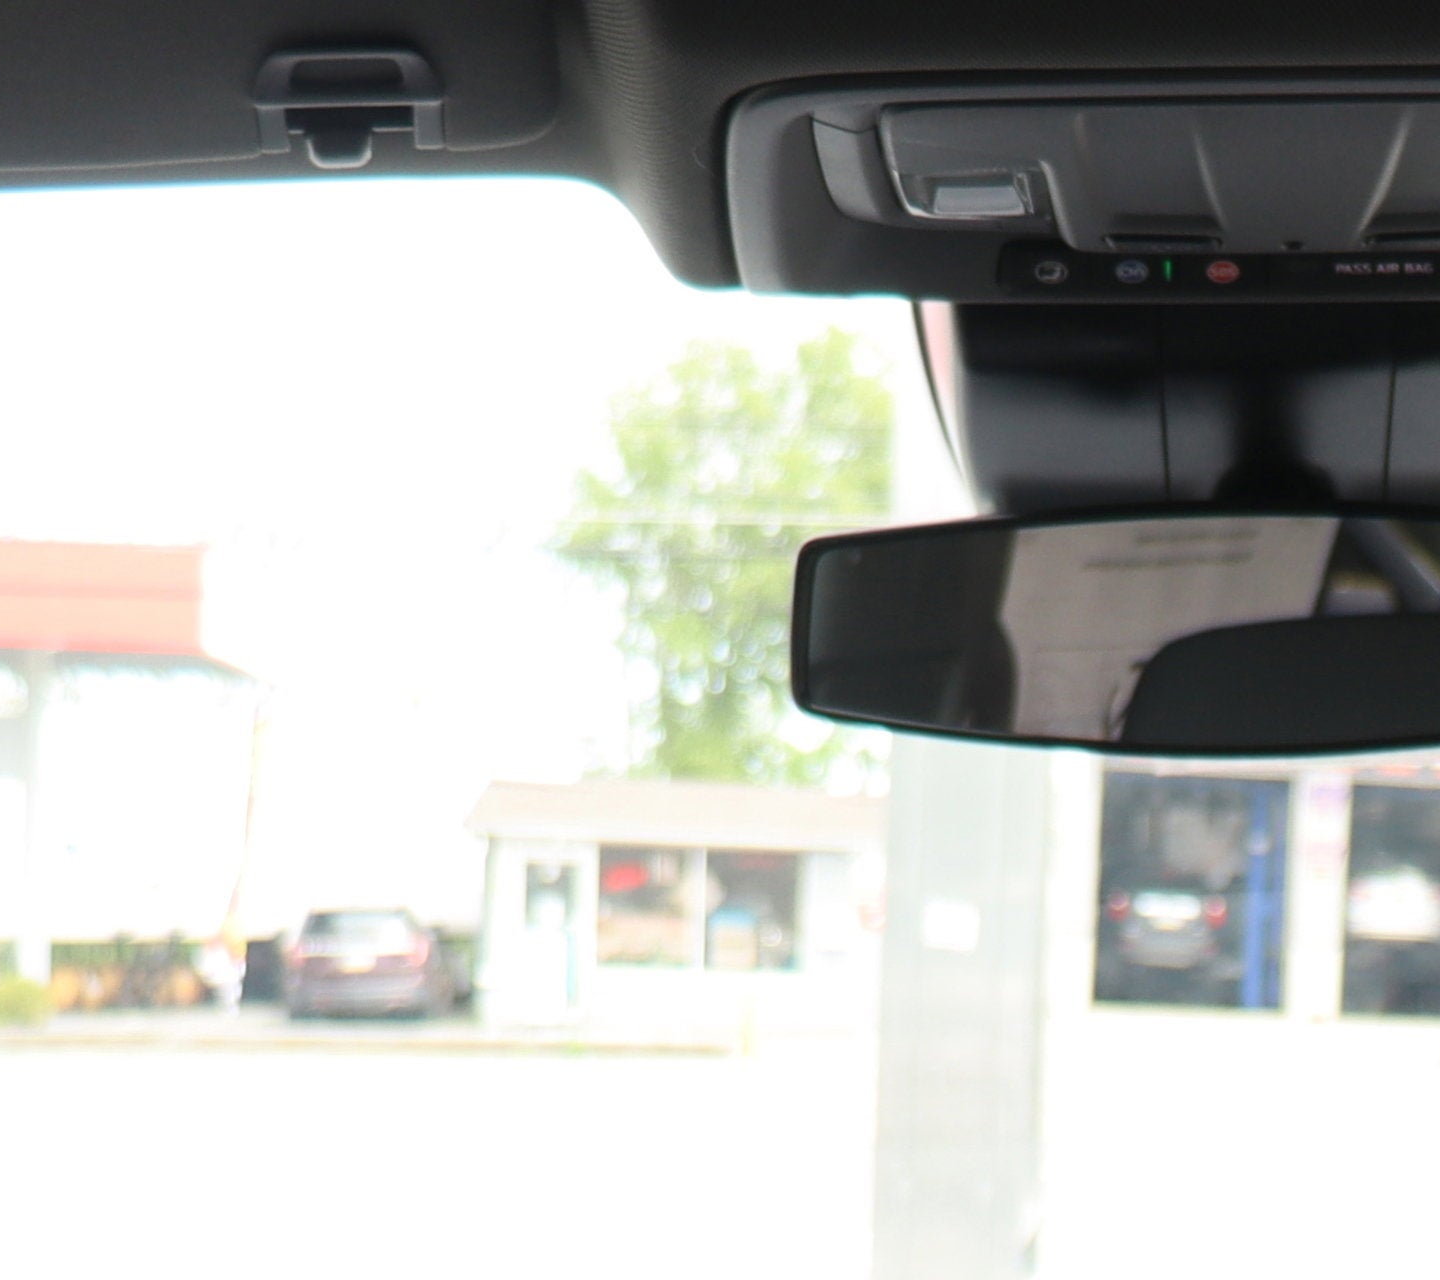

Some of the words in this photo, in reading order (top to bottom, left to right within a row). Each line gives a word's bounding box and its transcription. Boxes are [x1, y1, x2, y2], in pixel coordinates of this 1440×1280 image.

[1334, 262, 1372, 275] PASS
[1376, 262, 1400, 275] AIR
[1404, 262, 1435, 275] BAG
